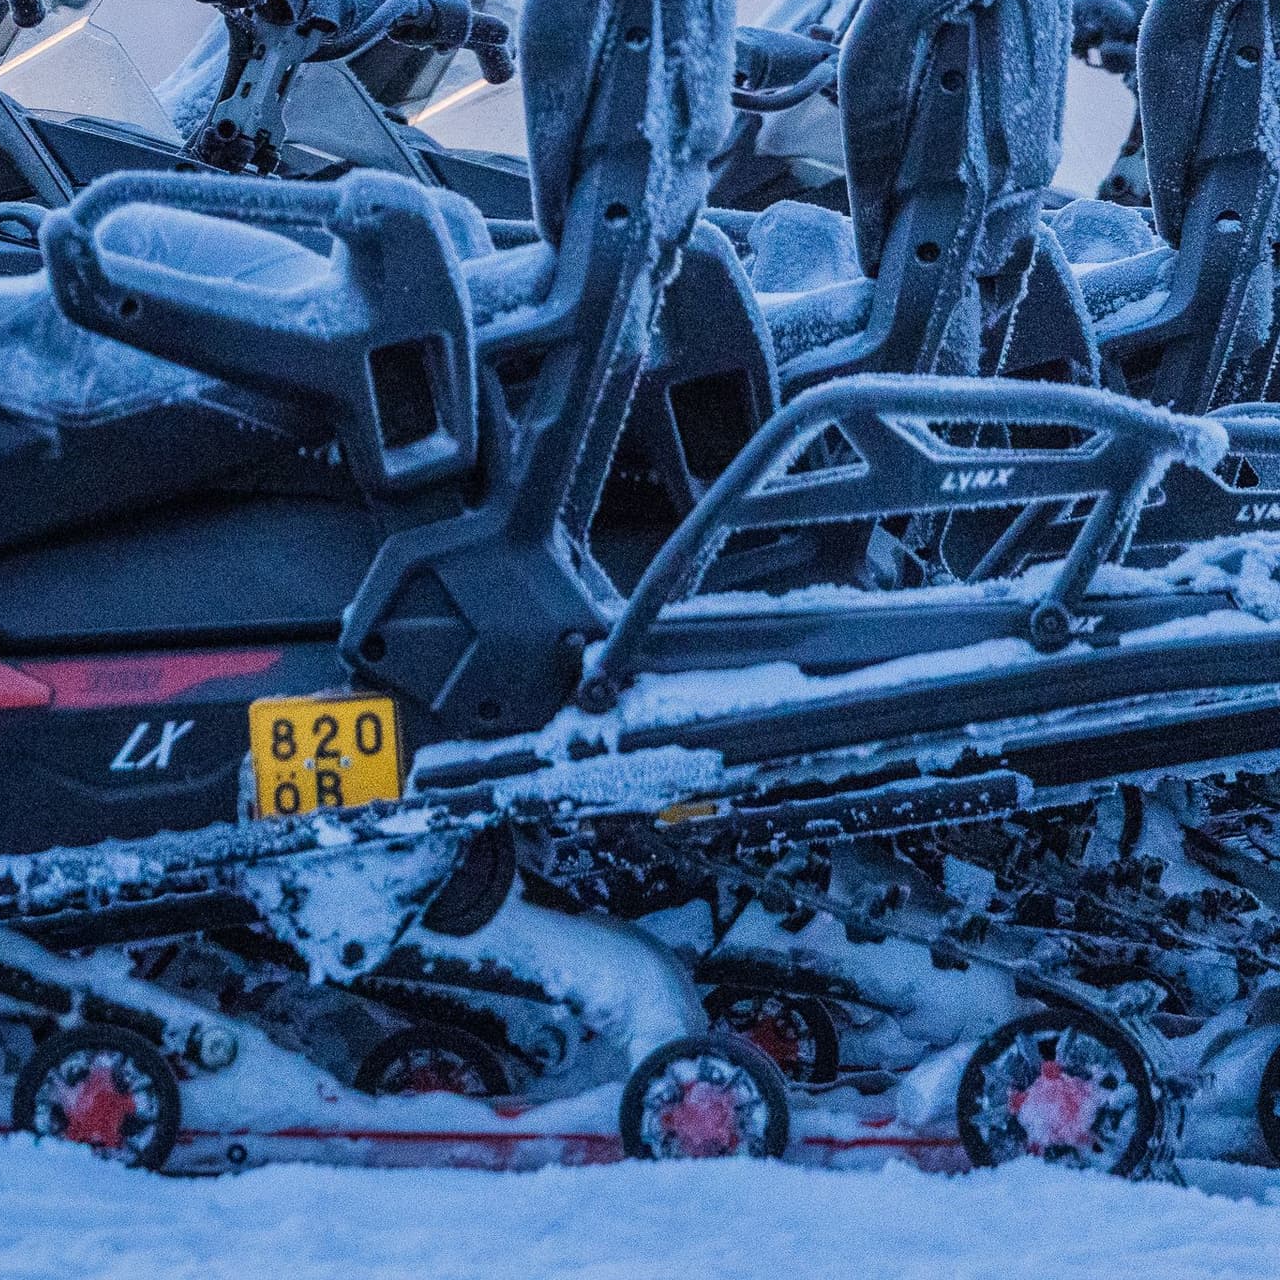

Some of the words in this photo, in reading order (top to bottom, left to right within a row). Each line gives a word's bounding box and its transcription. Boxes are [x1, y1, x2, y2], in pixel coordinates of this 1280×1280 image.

[940, 467, 1016, 492] LYNX
[109, 720, 195, 770] LX
[272, 711, 383, 761] 820
